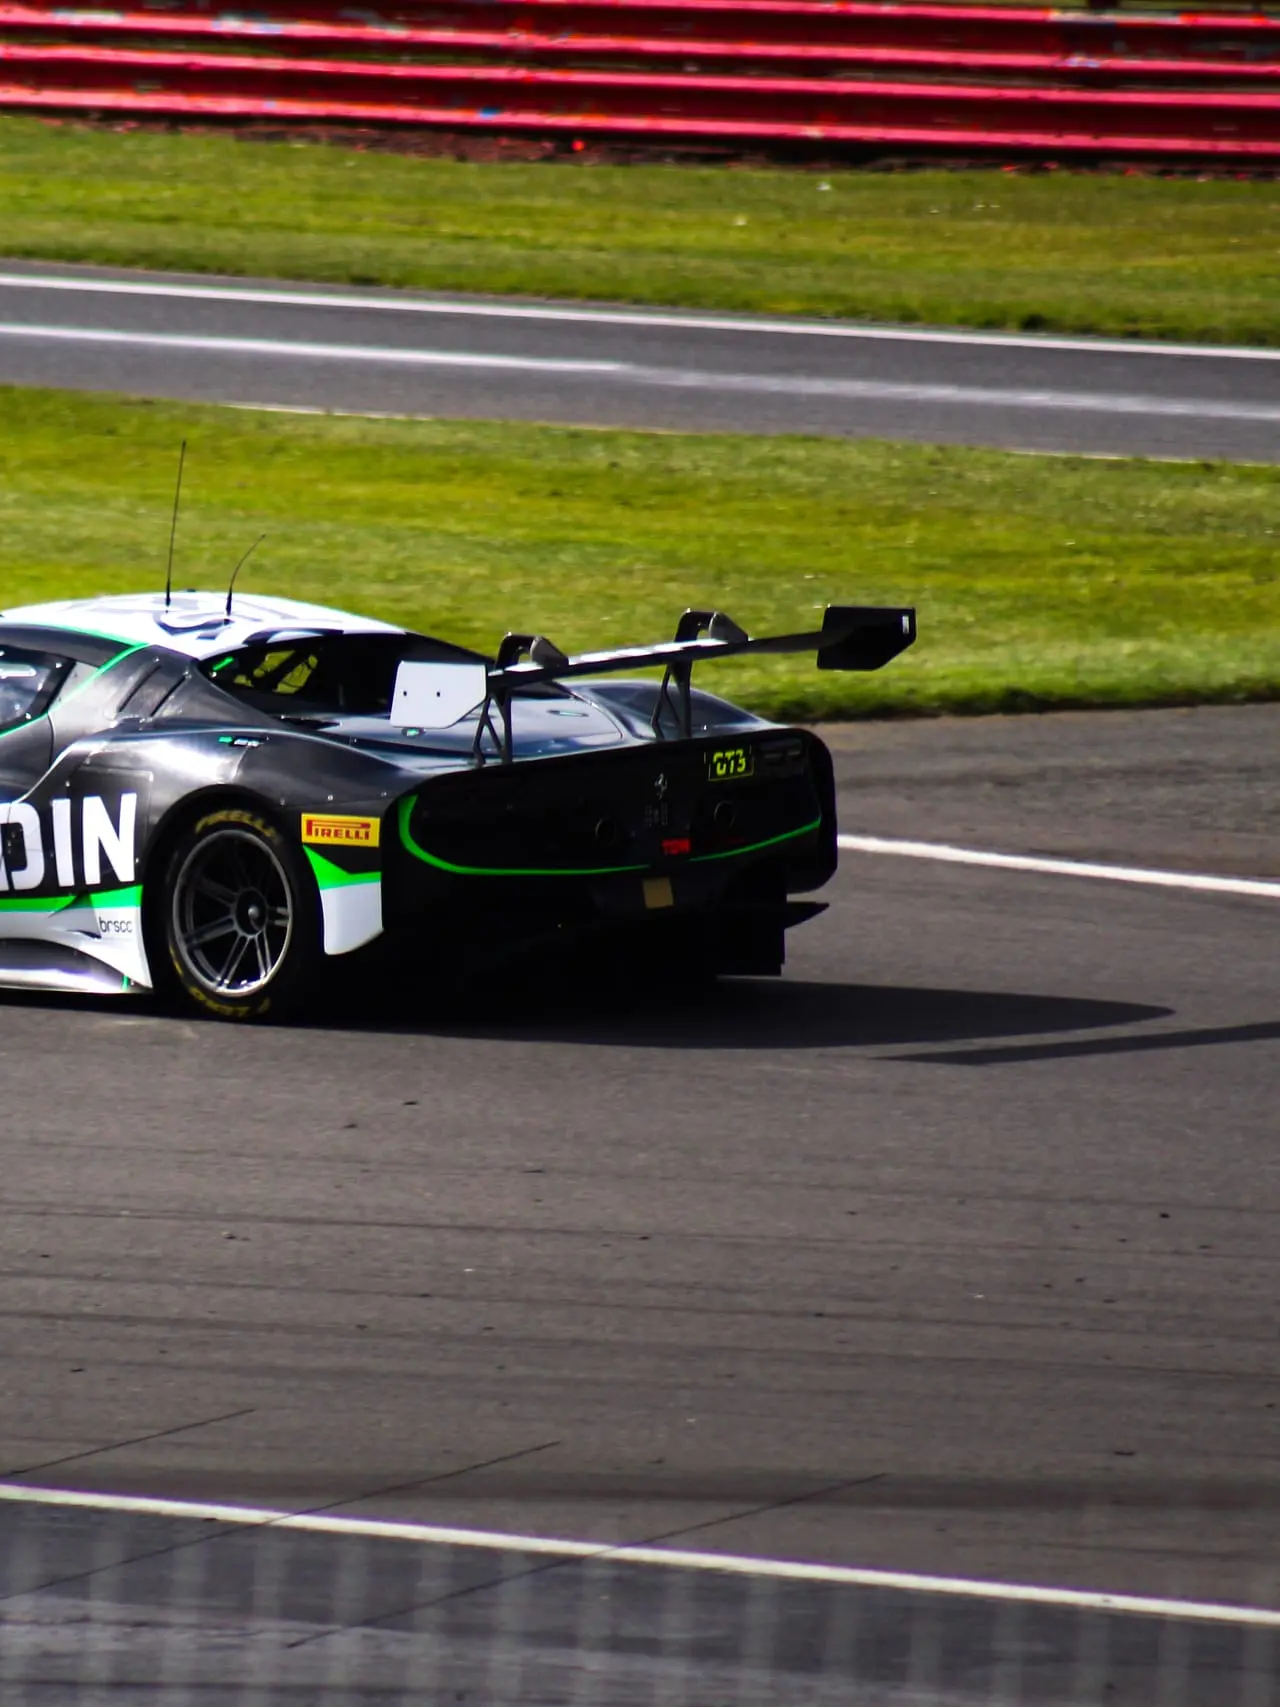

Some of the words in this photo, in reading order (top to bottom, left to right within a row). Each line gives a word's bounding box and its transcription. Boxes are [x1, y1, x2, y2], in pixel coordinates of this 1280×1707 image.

[713, 748, 746, 775] GT3
[306, 819, 371, 841] PIRELLI
[98, 915, 133, 934] brscc
